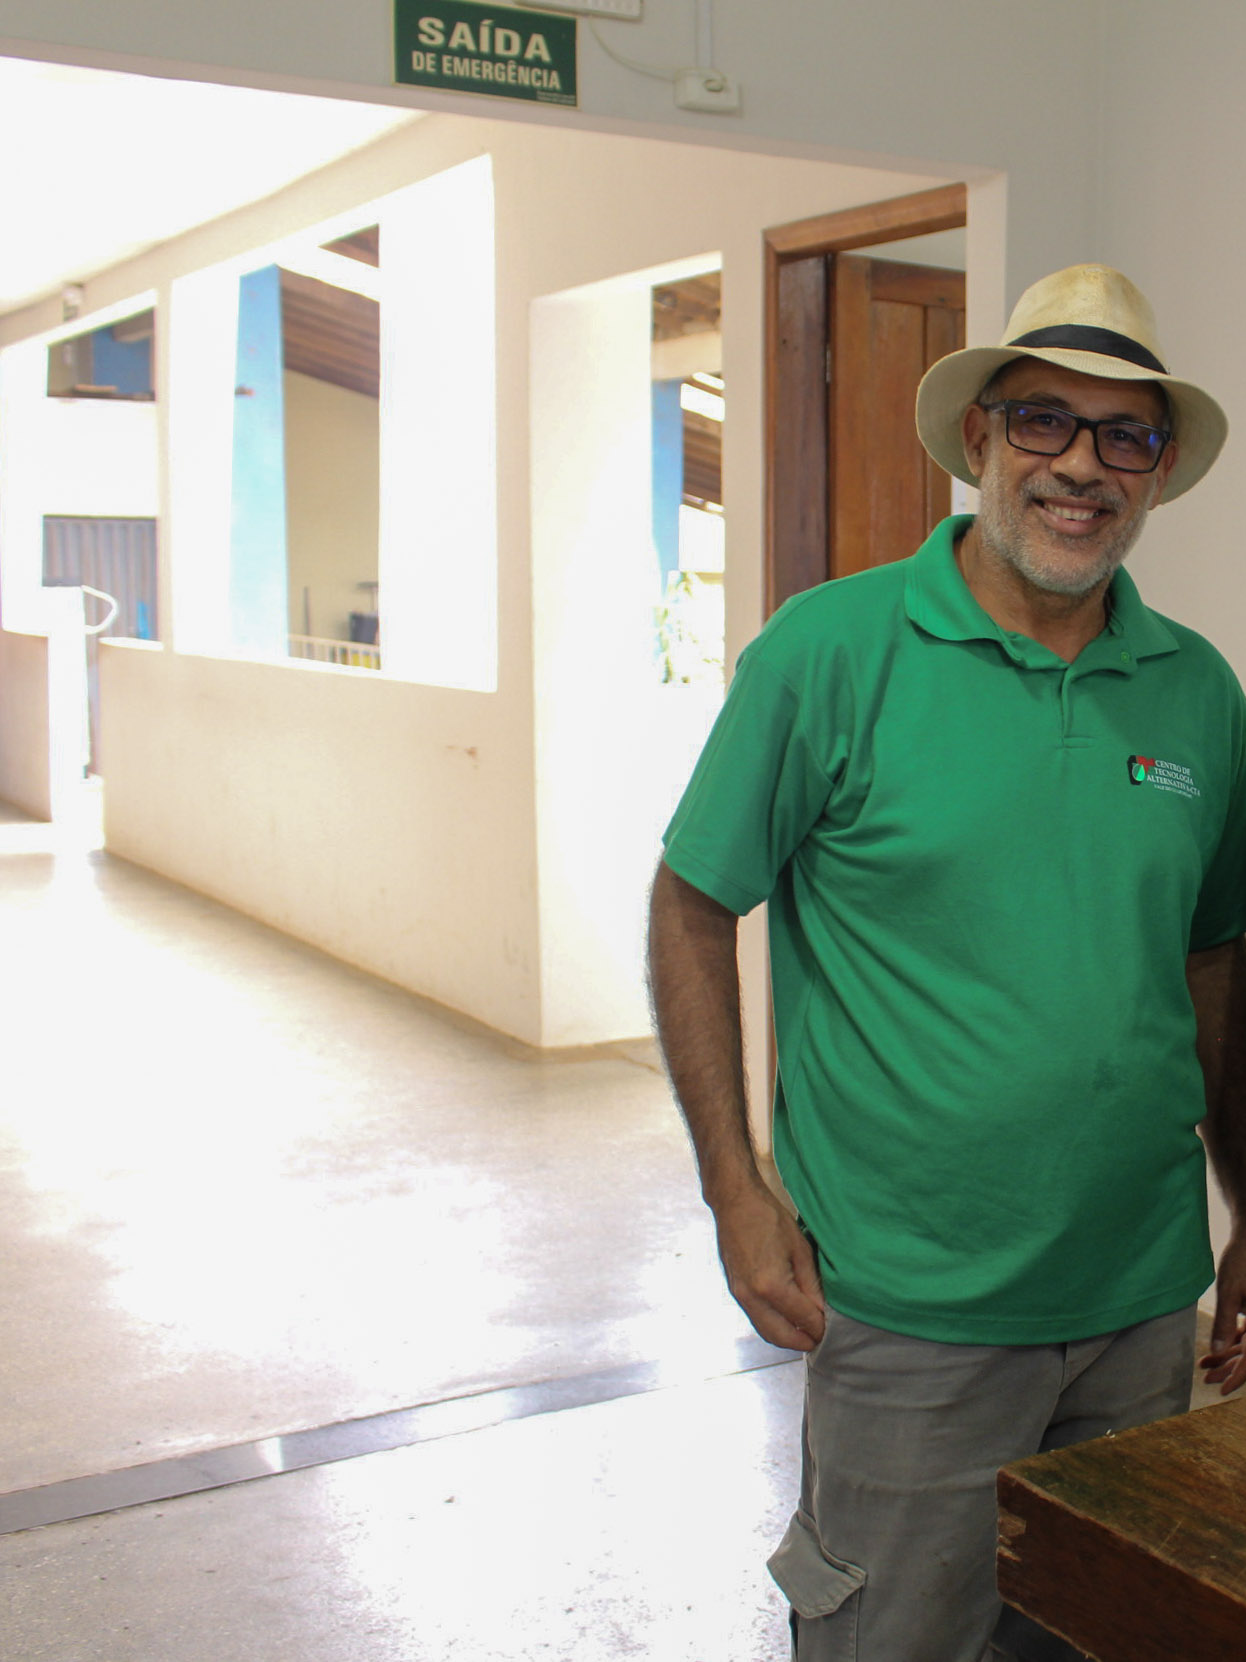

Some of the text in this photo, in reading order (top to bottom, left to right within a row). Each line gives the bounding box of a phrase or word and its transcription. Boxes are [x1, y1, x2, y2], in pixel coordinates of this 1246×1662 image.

[418, 17, 551, 62] SAÍDA
[412, 51, 562, 90] DE EMERGÊNCIA
[1154, 767, 1194, 785] TECNOLOGIA
[1155, 760, 1191, 776] CENTRO DE
